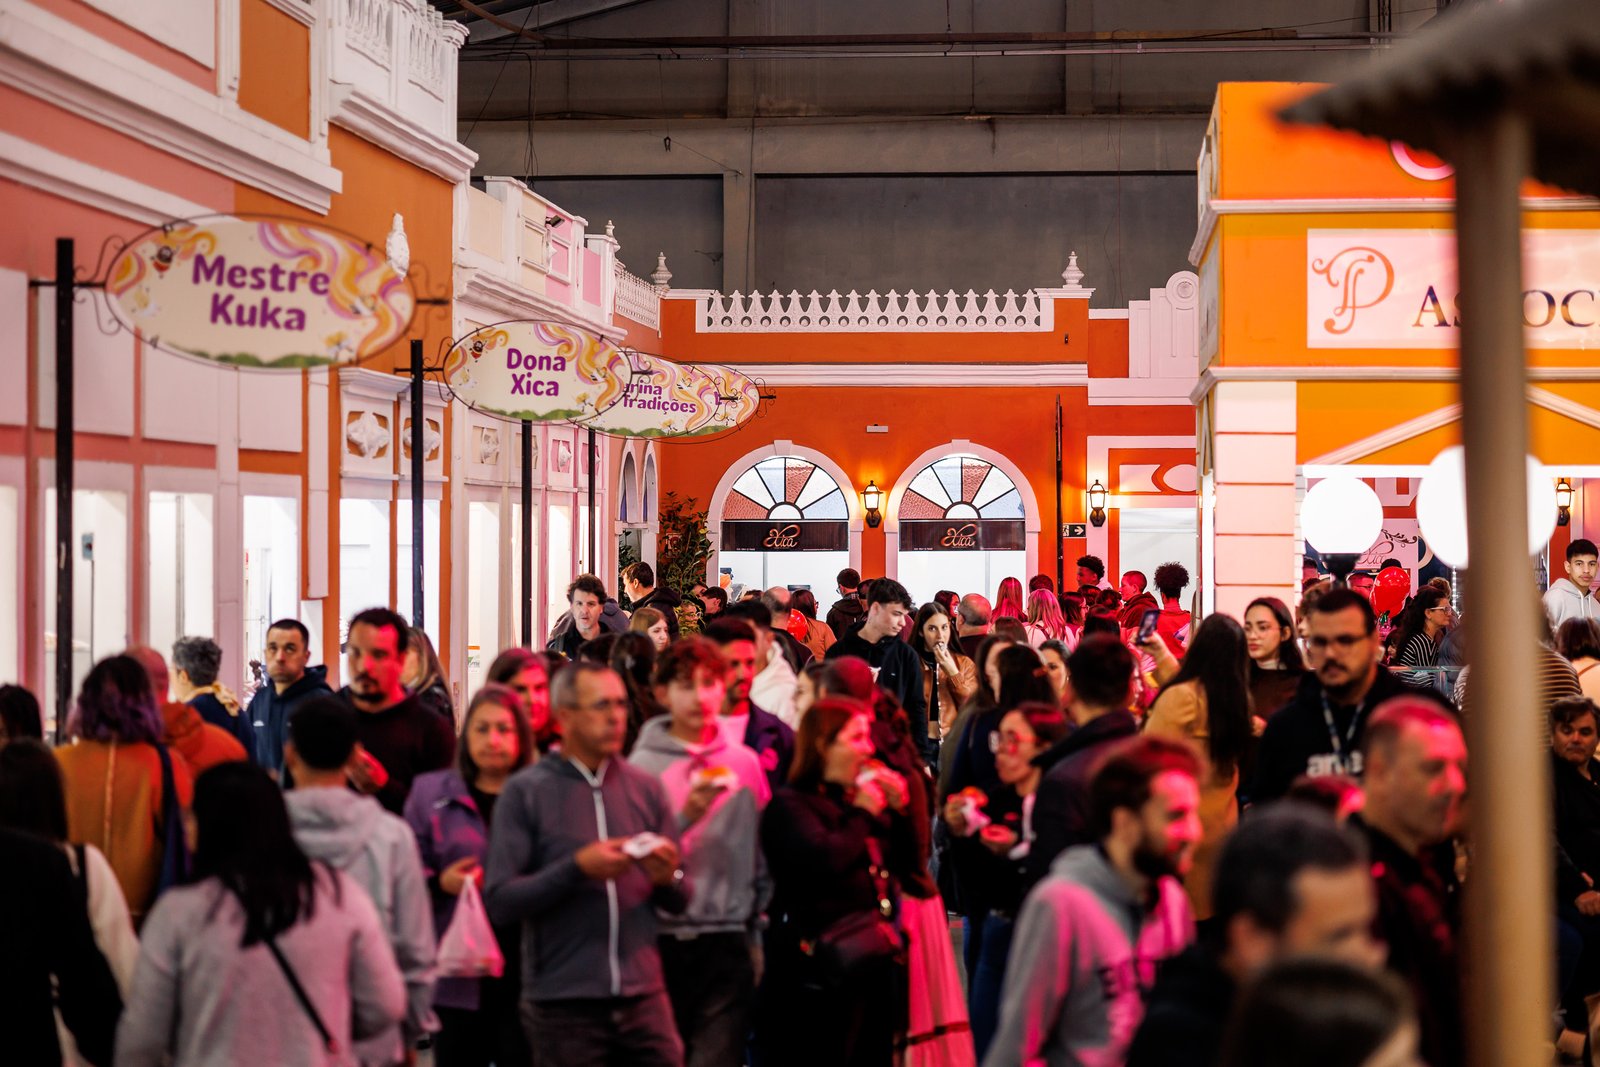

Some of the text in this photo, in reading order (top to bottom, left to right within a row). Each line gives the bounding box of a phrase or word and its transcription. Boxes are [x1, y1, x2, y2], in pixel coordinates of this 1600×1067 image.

[192, 253, 330, 295] Mestre
[210, 292, 307, 331] Kuka
[1412, 285, 1600, 328] AOC
[506, 347, 566, 371] Dona
[510, 371, 559, 396] Xica
